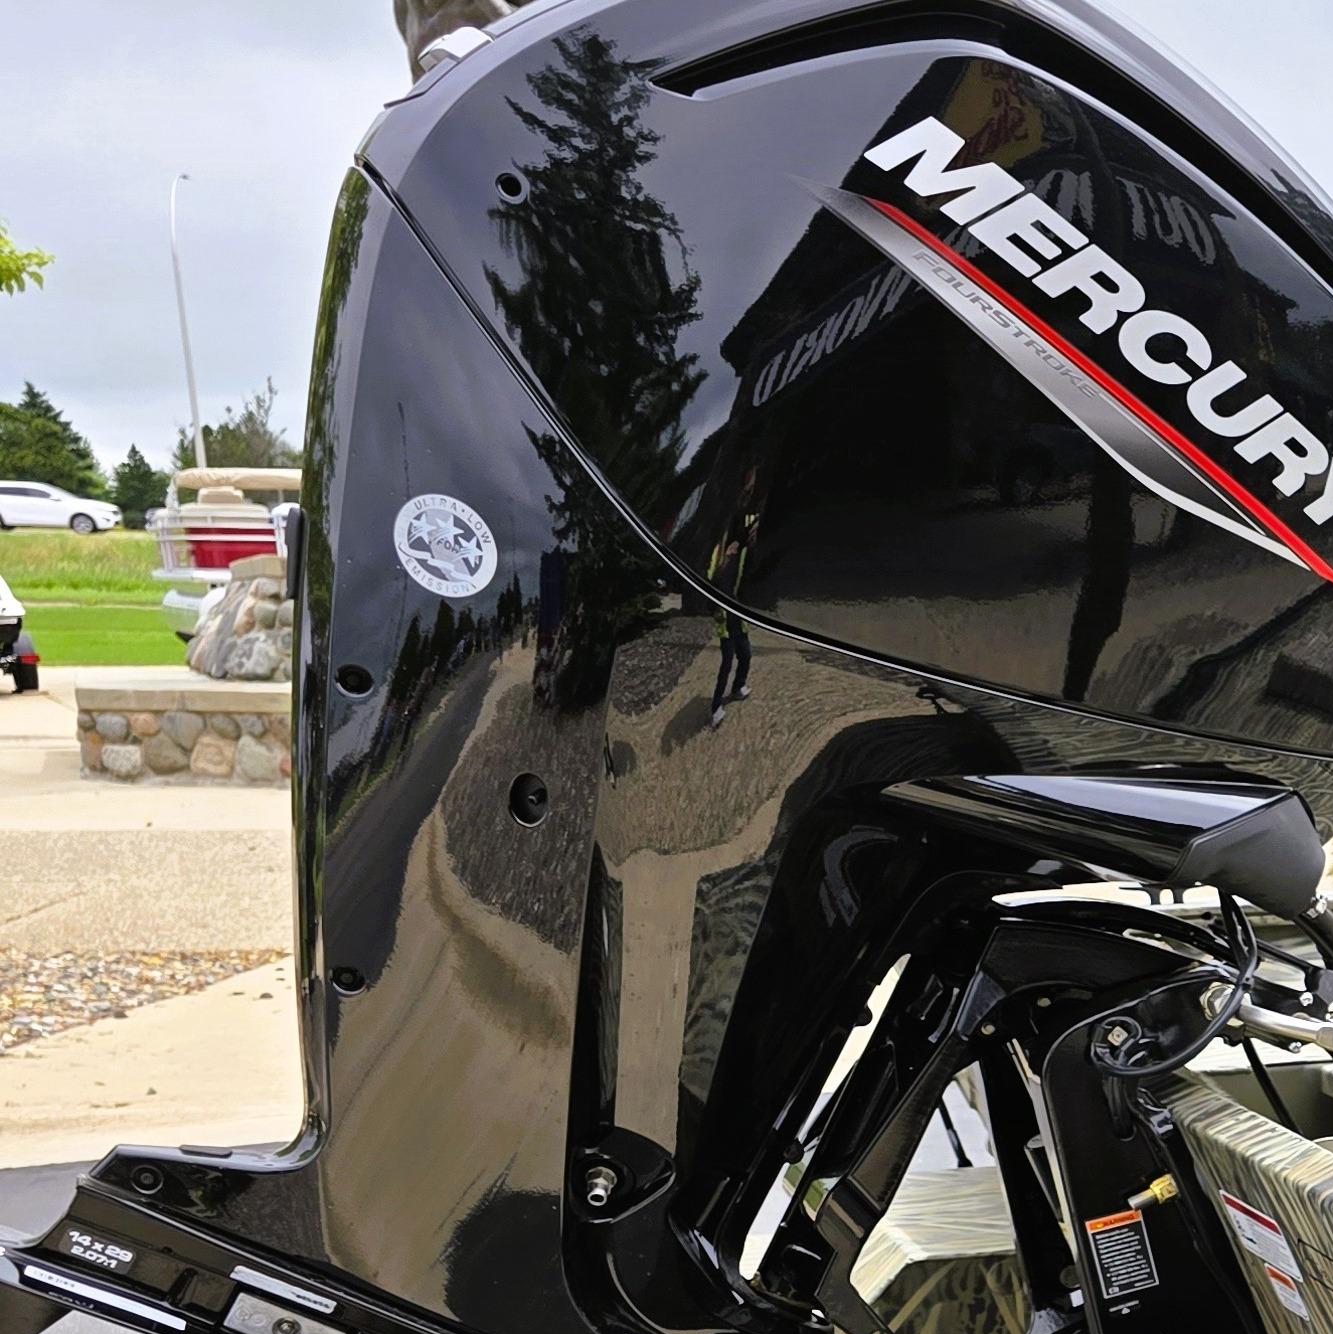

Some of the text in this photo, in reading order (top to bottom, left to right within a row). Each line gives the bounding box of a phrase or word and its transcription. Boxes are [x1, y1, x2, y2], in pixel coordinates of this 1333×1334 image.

[912, 250, 1097, 399] FOURSTROKE
[413, 497, 492, 544] ULTRA LOW
[404, 557, 470, 594] EMISSION
